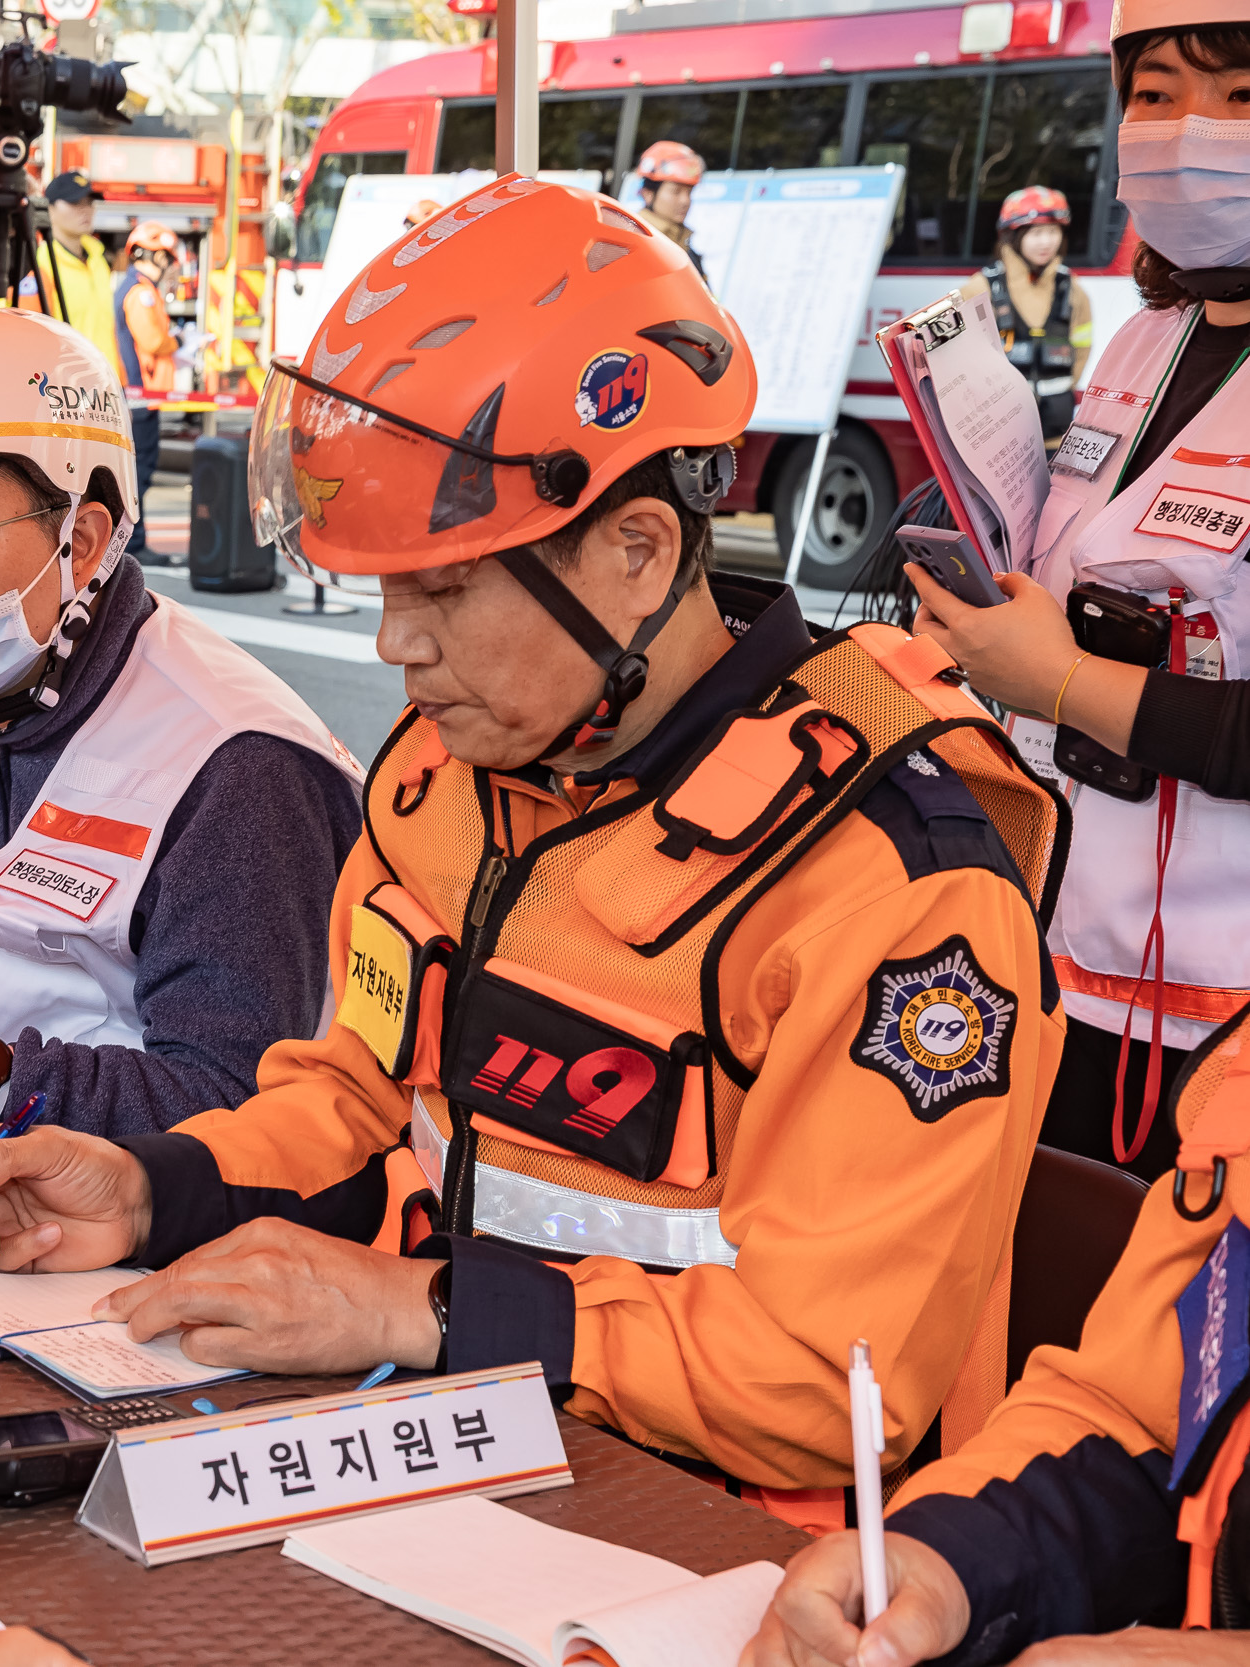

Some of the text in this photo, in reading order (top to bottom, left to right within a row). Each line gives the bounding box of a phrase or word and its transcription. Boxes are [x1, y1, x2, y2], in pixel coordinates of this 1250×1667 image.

[45, 385, 120, 417] SDMAT
[597, 353, 648, 417] 119
[1060, 435, 1105, 461] 광진구보건소
[1154, 500, 1243, 538] 행정지원총괄
[7, 860, 101, 905] 현장응급의료소장
[351, 950, 404, 1024] 자원지원부
[902, 1027, 979, 1069] KOREA FIRE SERVICE
[919, 1018, 966, 1042] 119
[470, 1034, 657, 1139] 119
[201, 1408, 496, 1506] 자원지원부
